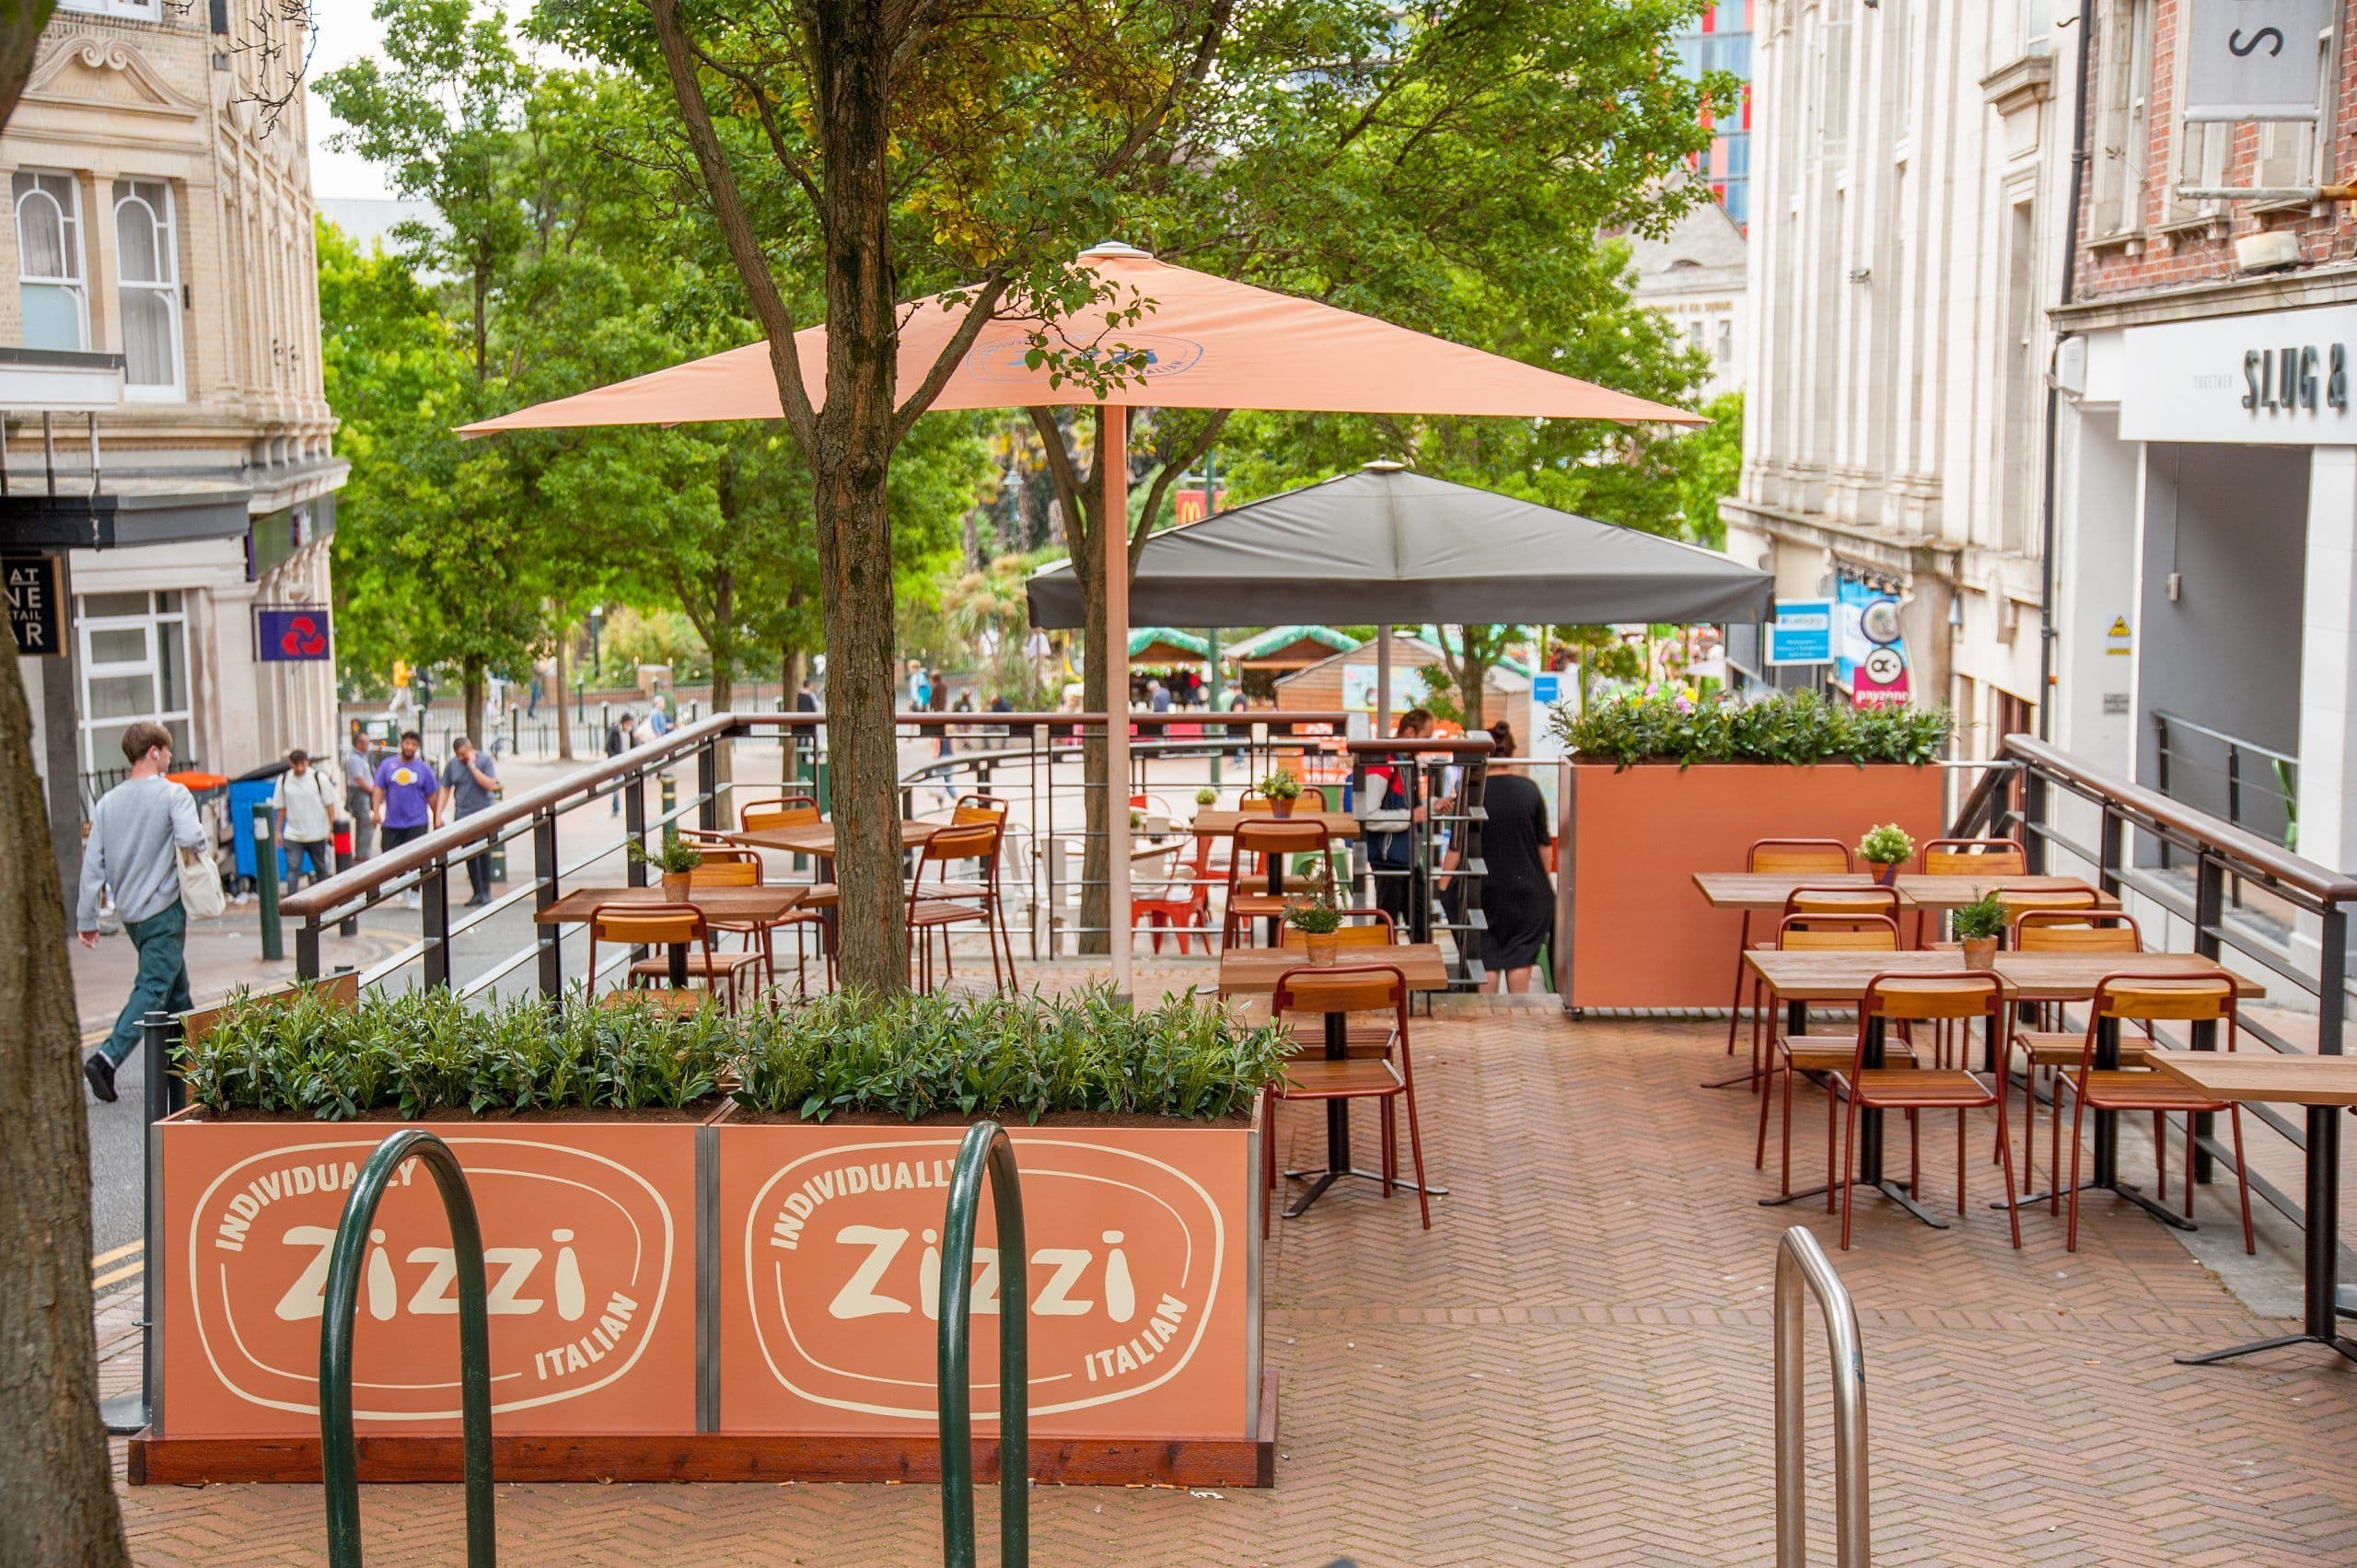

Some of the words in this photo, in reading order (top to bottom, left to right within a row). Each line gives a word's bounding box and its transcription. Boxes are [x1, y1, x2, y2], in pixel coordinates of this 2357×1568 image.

[2241, 344, 2319, 412] SLUG
[2327, 343, 2347, 412] &
[4, 587, 42, 609] NE
[12, 610, 42, 621] TAIL
[215, 1158, 418, 1252] INDIVIDUAY
[770, 1158, 956, 1250] INDIVIDUALL
[274, 1225, 586, 1322] Zizzi
[828, 1225, 1136, 1323] Zizzi
[534, 1291, 639, 1381] ITALIAN
[1084, 1293, 1189, 1382] ITALIAN
